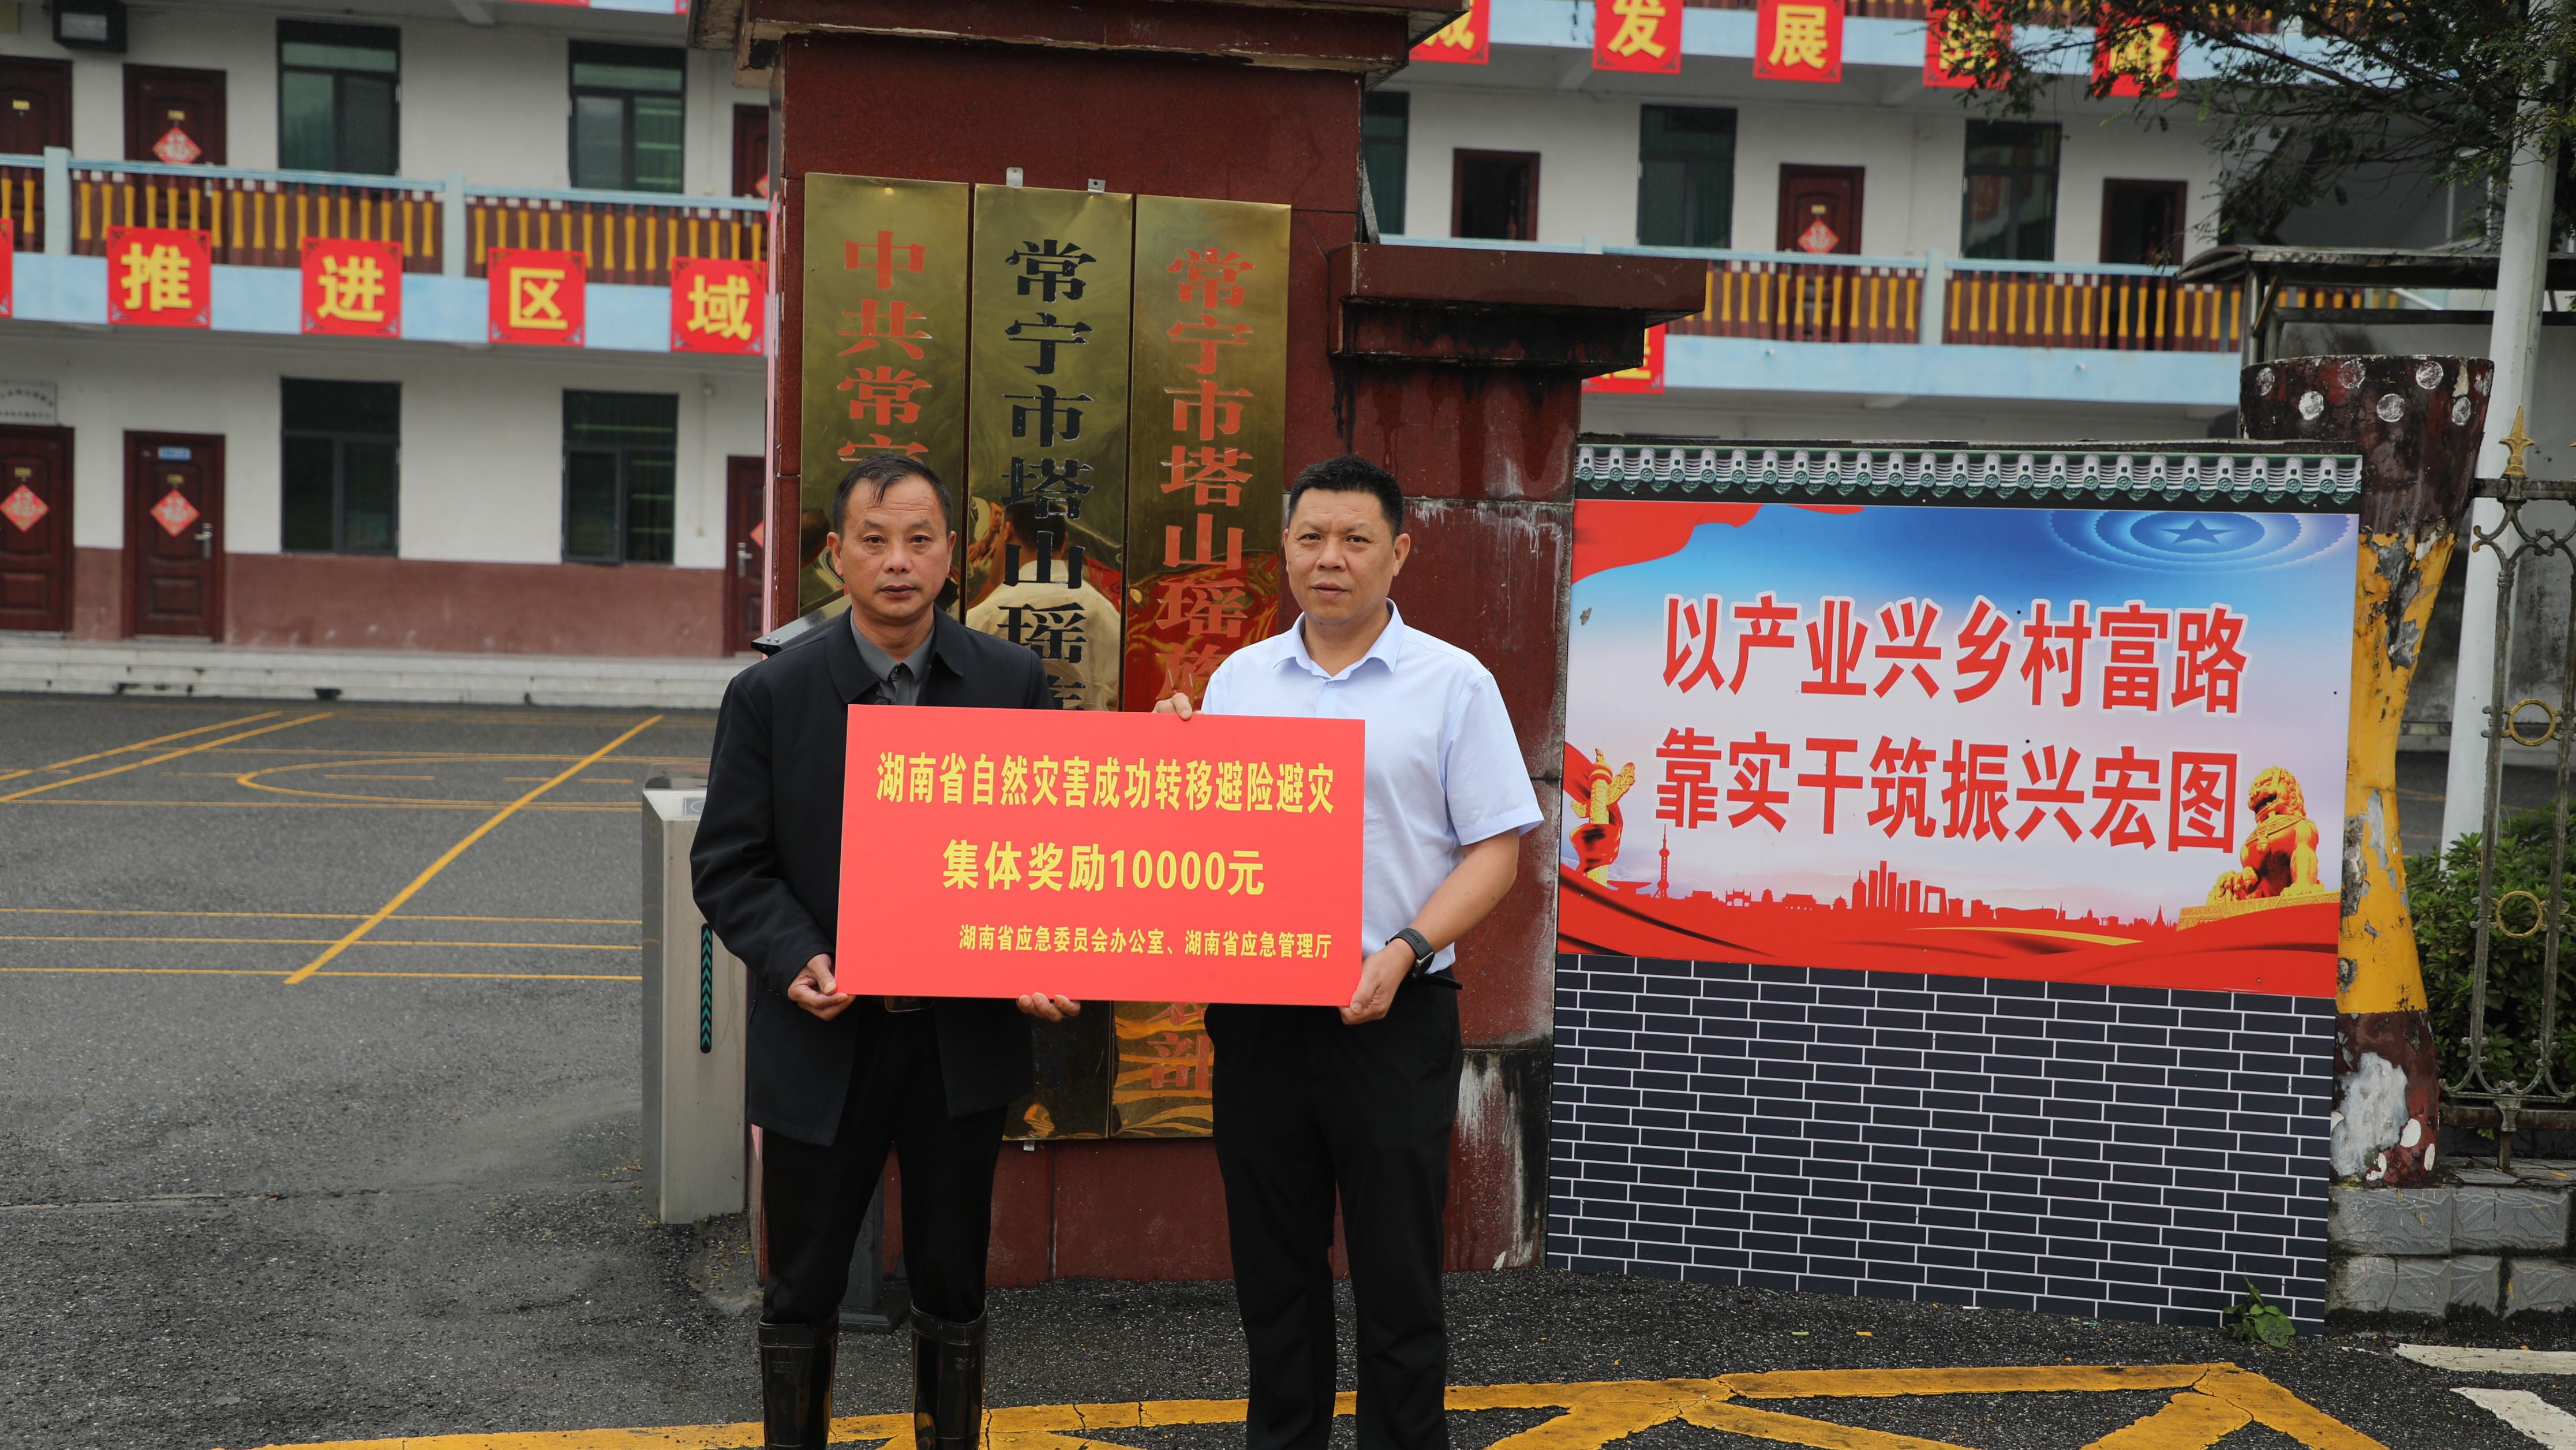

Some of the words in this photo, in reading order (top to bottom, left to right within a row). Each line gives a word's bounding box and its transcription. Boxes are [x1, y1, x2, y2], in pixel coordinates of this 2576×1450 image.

[1661, 593, 2248, 713] 以产业兴乡村富路
[876, 752, 1335, 814] 湖南省自然灾害成功转移避险避灾
[1655, 727, 2238, 853] 靠实干筑振兴宏图
[942, 839, 1265, 896] 集体奖励10000元
[958, 924, 1333, 959] 湖南省应急委员会办公室、湖南省应急管理厅
